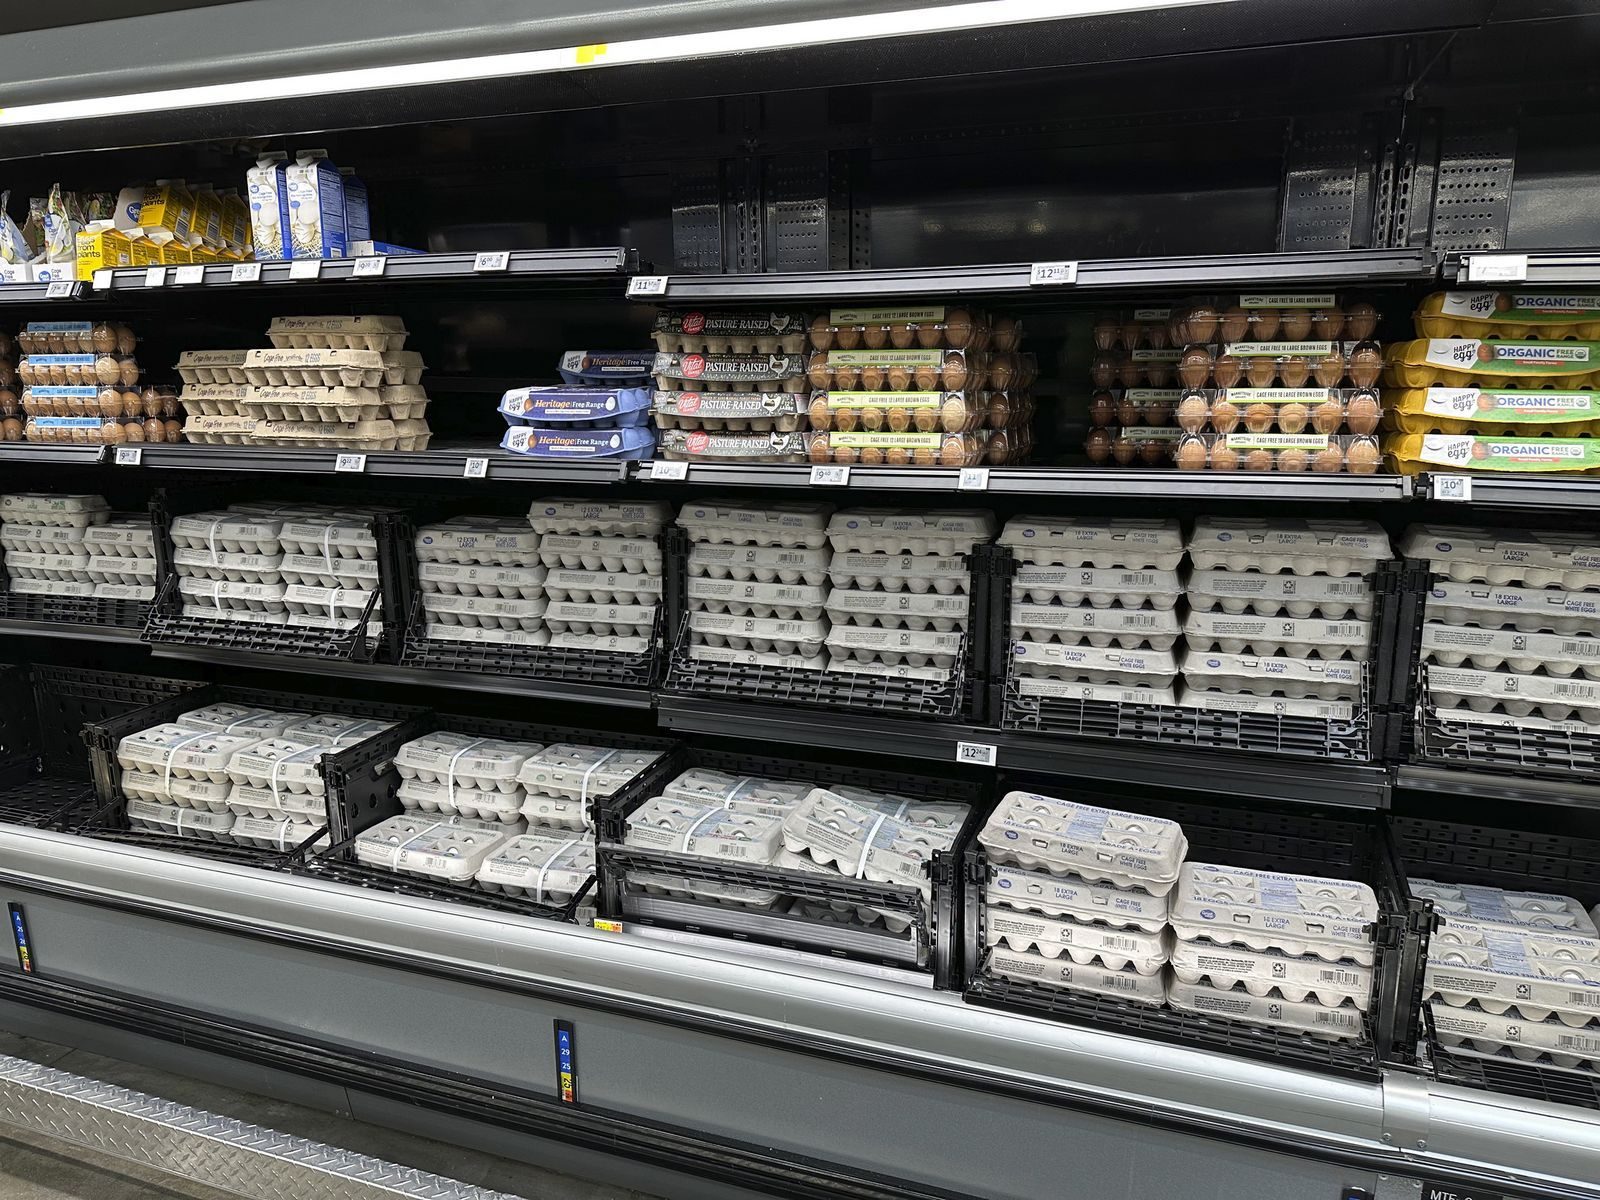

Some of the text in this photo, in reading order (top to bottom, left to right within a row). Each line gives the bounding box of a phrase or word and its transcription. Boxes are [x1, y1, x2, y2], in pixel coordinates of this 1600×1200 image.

[1470, 293, 1494, 303] HAPPY
[1516, 297, 1575, 307] ORGANIC
[1470, 301, 1491, 312] egg
[682, 316, 703, 328] Vital
[705, 319, 769, 329] PASTURE-RAISED
[1453, 343, 1476, 353] HAPPY
[1497, 348, 1555, 358] ORGANIC
[1453, 350, 1473, 362] egg
[592, 358, 626, 367] Heritage
[640, 359, 654, 367] Rang
[682, 359, 702, 371] Vital
[705, 362, 768, 372] PASTURE-RAISED
[1452, 393, 1475, 403] HAPPY
[1498, 397, 1555, 407] ORGANIC
[535, 400, 571, 408] Heritage
[586, 401, 605, 410] Range
[700, 400, 761, 410] PASTURE-RAISED
[1452, 400, 1474, 411] egg
[538, 436, 575, 445] Heritage
[590, 438, 609, 447] Range
[708, 438, 769, 449] PASTURE-RAISED
[1447, 441, 1470, 451] HAPPY
[1447, 448, 1468, 460] egg
[1491, 445, 1550, 455] ORGANIC
[1503, 594, 1523, 602] EXTRA
[1056, 800, 1075, 809] CAGE
[1091, 807, 1110, 815] EXTRA
[1111, 811, 1132, 819] LARGE
[1060, 888, 1078, 896] EXTRA
[561, 1048, 570, 1056] 29
